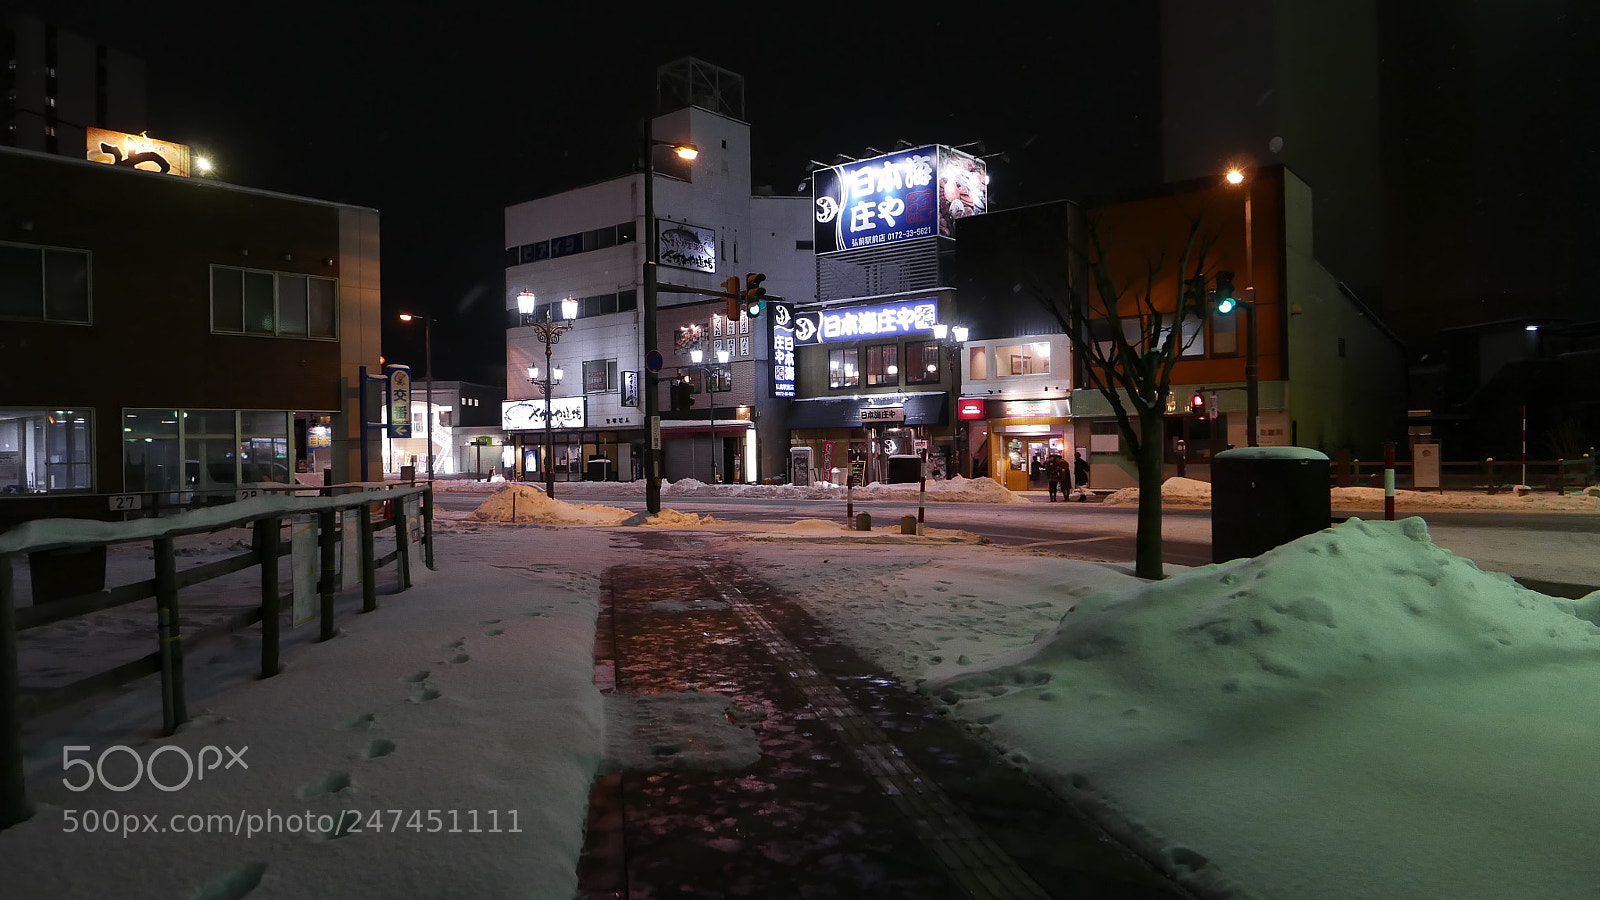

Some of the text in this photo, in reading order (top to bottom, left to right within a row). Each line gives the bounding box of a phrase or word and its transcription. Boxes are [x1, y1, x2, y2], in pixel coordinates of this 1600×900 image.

[851, 155, 932, 198] 日本海
[850, 196, 905, 232] 庄や
[851, 226, 931, 247] 弘前駅前店 0172-33-5621
[824, 306, 916, 338] 日本海庄や
[774, 335, 784, 364] 庄や
[393, 388, 408, 420] 交番
[861, 410, 896, 420] 日本海庄や
[116, 496, 134, 509] 27
